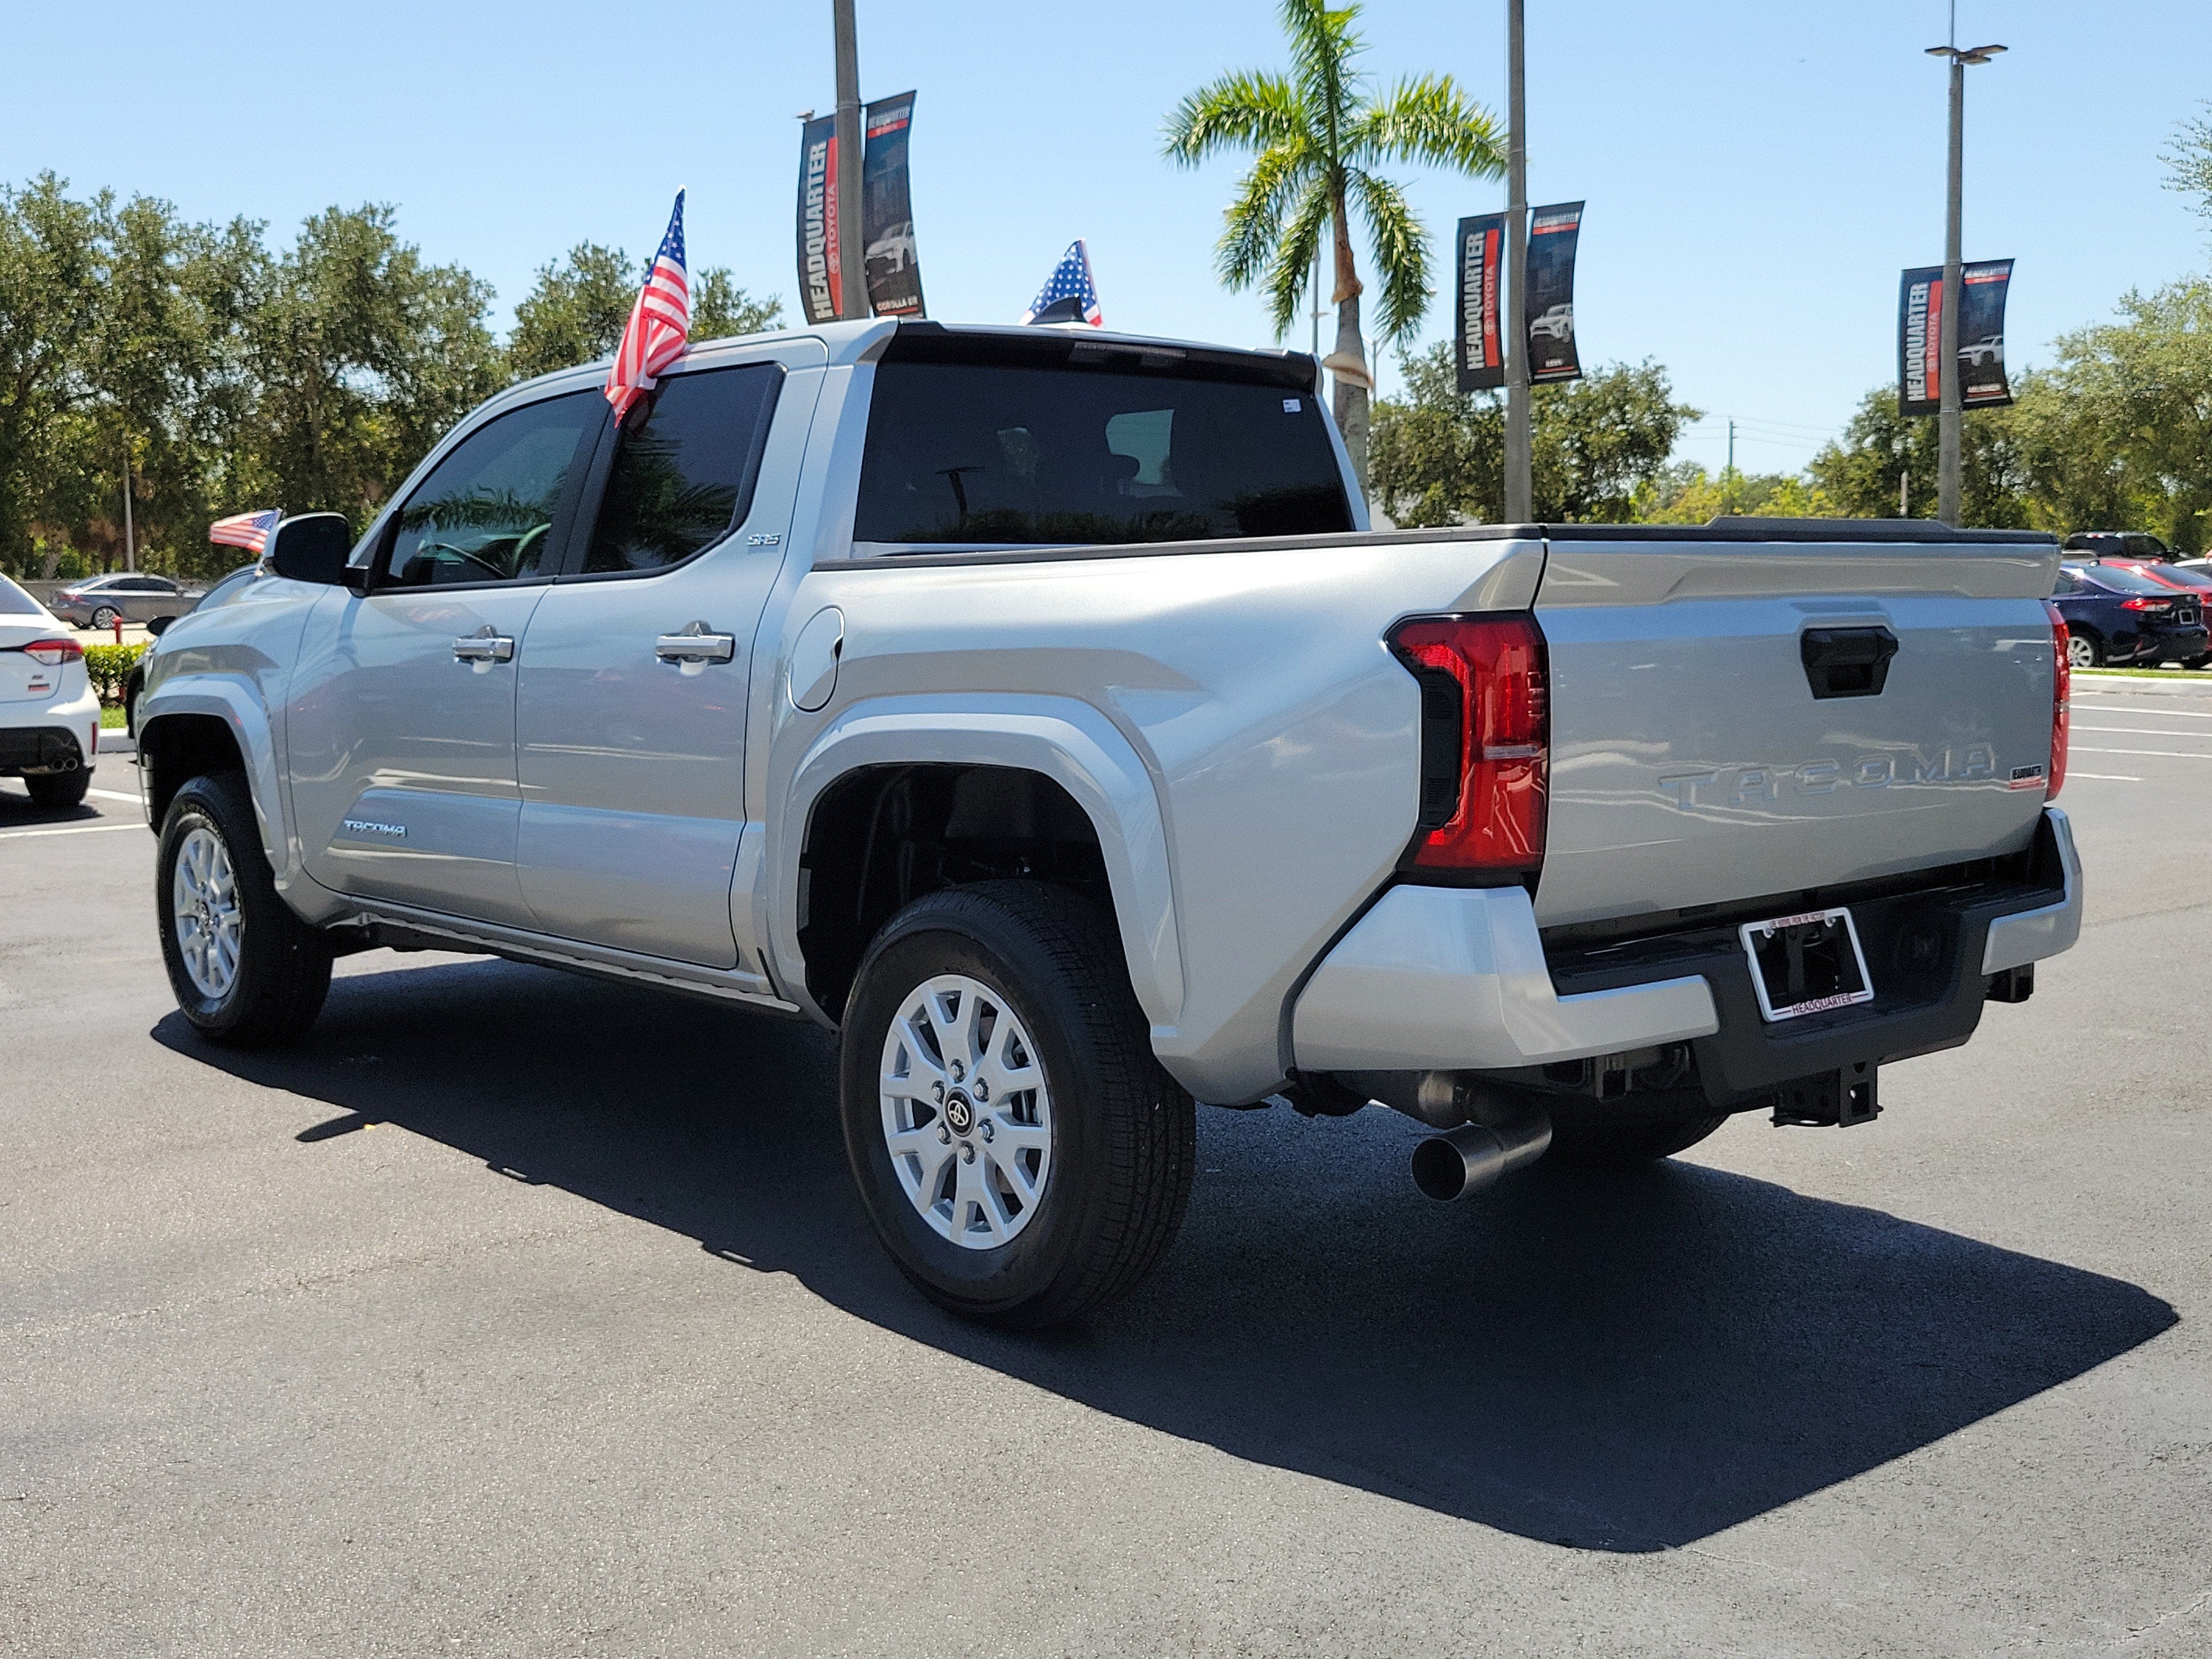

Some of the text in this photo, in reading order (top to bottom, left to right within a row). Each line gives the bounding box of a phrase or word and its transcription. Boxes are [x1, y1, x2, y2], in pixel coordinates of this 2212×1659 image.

[805, 141, 834, 320] HEADQUARTER
[827, 183, 837, 250] TOYOTA
[1464, 231, 1485, 370] HEADQUARTER
[1484, 264, 1495, 317] TOYOTA
[1906, 281, 1929, 401] HEADQUARTER
[1927, 312, 1939, 356] TOYOTA
[747, 533, 781, 546] SR5
[1658, 742, 1996, 811] TACOMA
[343, 820, 407, 837] TACOMA
[1792, 993, 1852, 1015] HEADQUARTER
